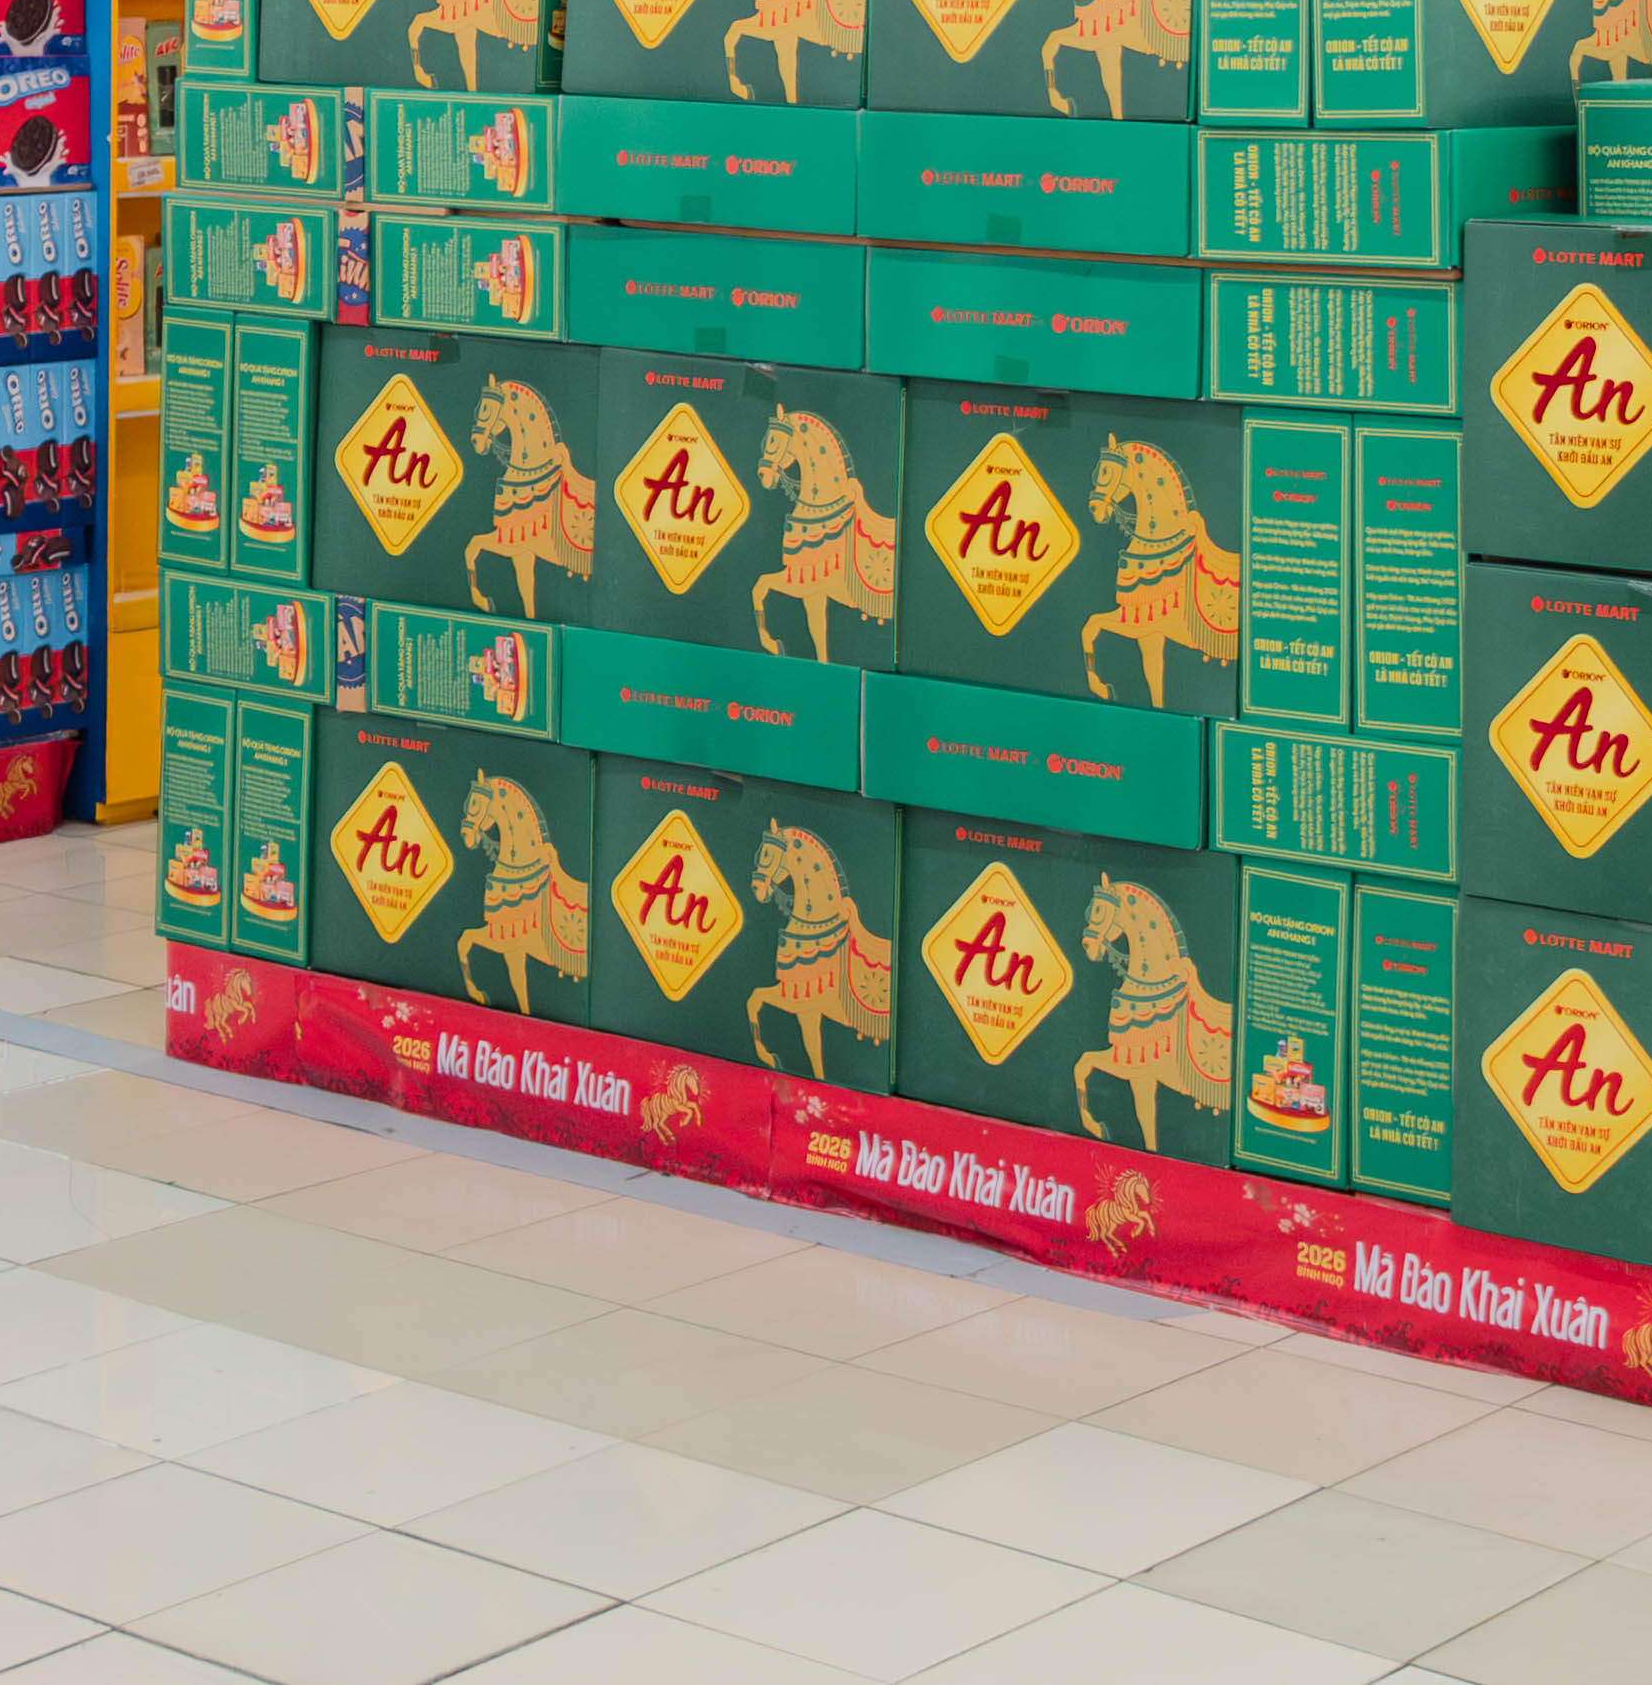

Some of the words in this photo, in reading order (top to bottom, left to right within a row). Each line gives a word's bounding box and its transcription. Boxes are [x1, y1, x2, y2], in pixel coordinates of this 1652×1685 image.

[1548, 252, 1595, 264] LOTTE
[1599, 253, 1643, 267] MART
[1574, 321, 1609, 330] ORION
[1531, 336, 1645, 425] An
[940, 741, 982, 762] LOTTE
[985, 747, 1029, 765] MART
[1064, 758, 1125, 781] ORION
[393, 1036, 430, 1059] 2026
[437, 1032, 467, 1077] Mã
[475, 1040, 514, 1089] Đáo
[520, 1050, 568, 1101] Khai
[574, 1064, 629, 1115] Xuân
[1297, 1265, 1321, 1280] BÍNH
[1322, 1271, 1343, 1289] NGỌ
[1297, 1242, 1346, 1272] 2026
[1354, 1241, 1394, 1299] Mã
[1401, 1252, 1450, 1313] Đáo
[1459, 1267, 1525, 1330] Khai
[1531, 1283, 1607, 1349] Xuân
